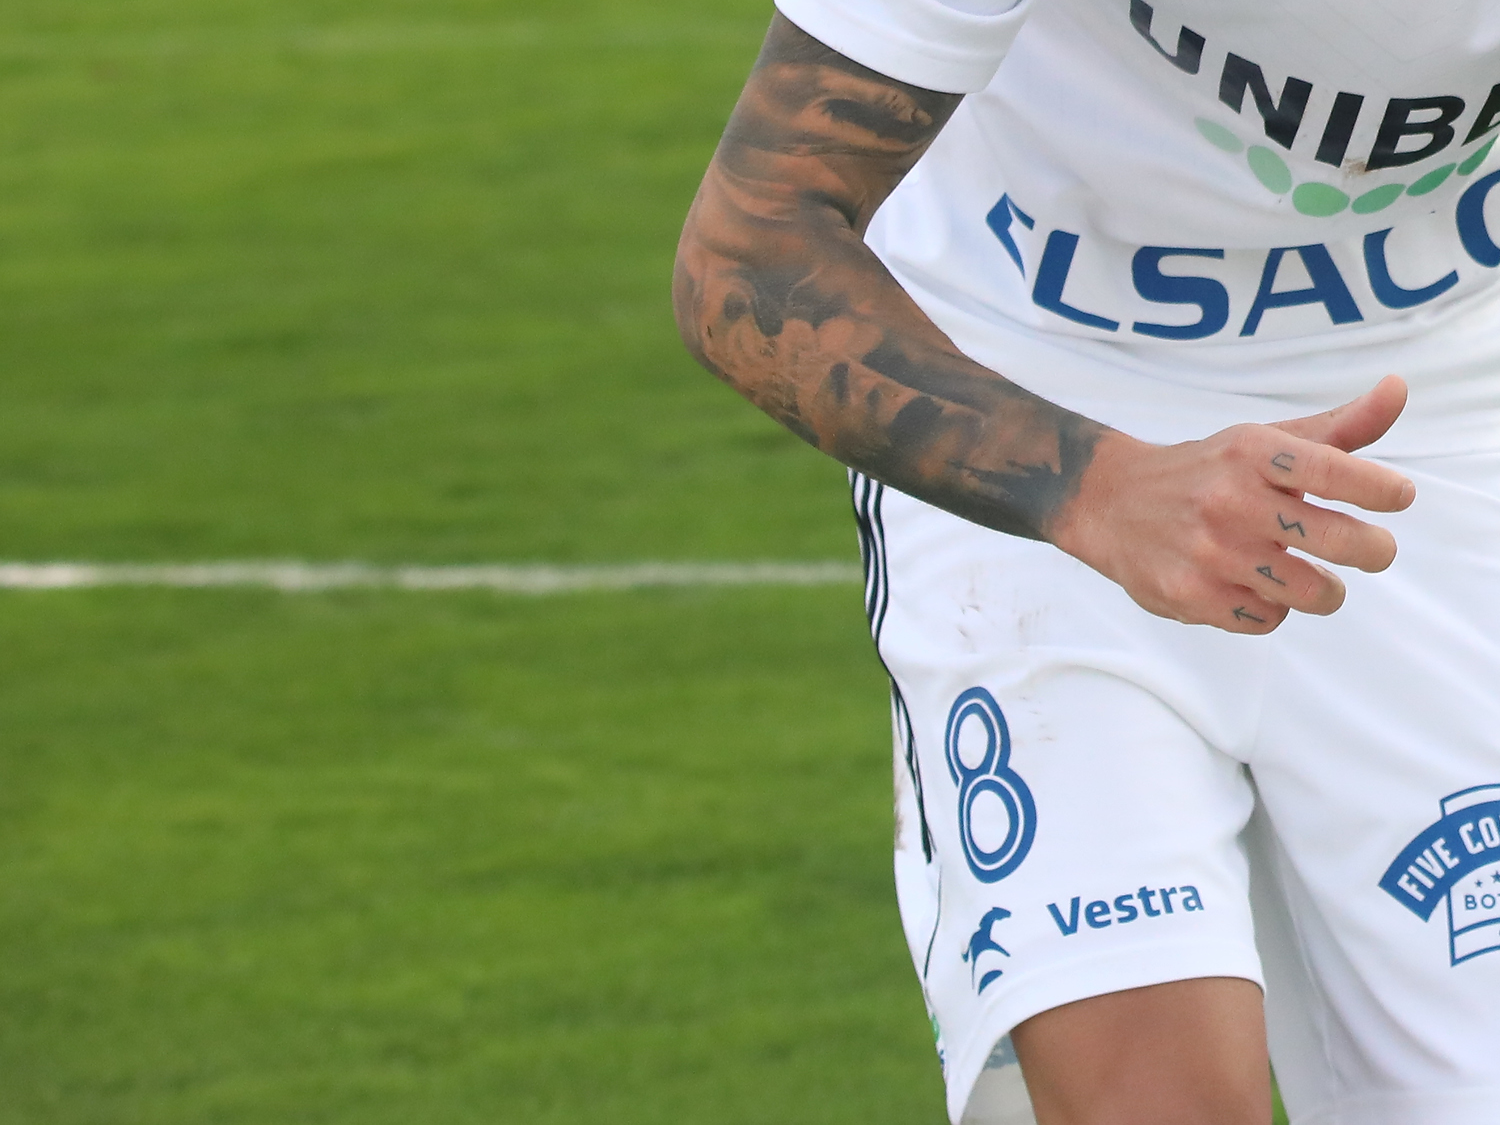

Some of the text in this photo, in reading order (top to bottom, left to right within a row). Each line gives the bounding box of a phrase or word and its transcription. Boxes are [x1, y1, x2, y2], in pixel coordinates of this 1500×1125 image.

[944, 686, 1037, 884] 8
[1396, 836, 1460, 903] FIVE
[1046, 884, 1204, 937] Vestra
